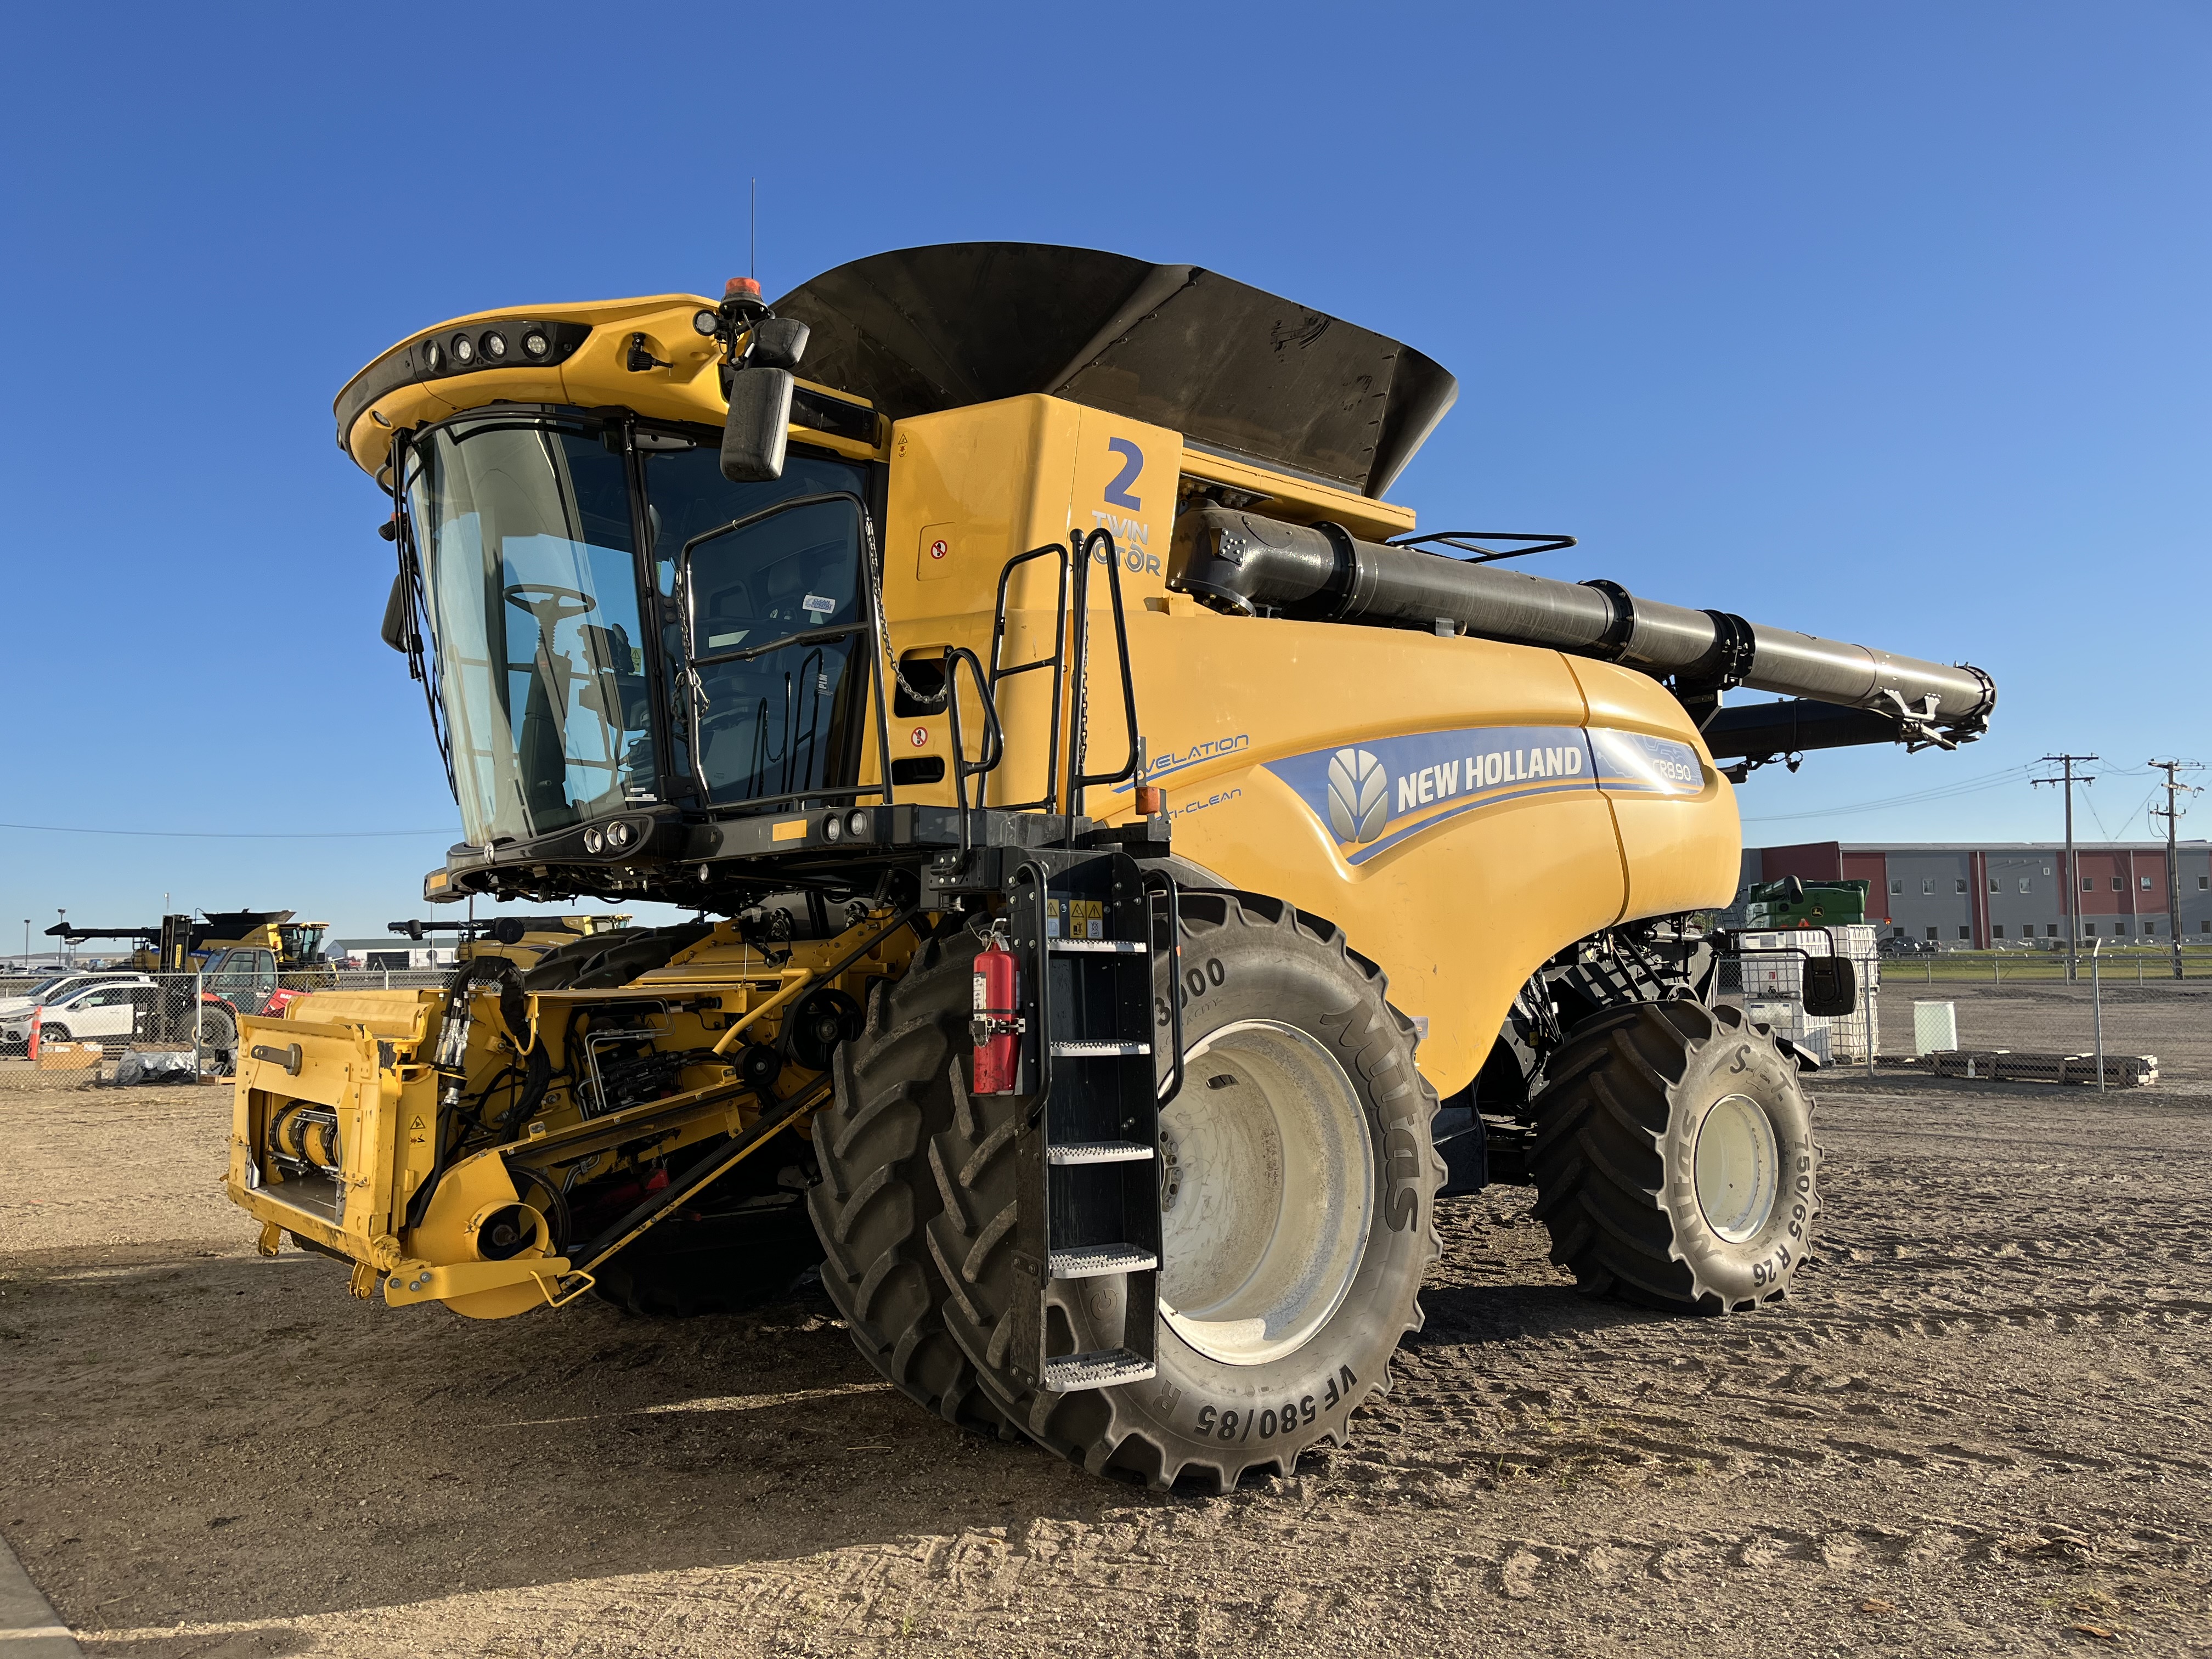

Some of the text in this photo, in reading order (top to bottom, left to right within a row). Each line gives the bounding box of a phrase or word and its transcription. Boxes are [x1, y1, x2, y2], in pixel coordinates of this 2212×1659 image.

[1104, 437, 1144, 512] 2
[1092, 510, 1148, 545] TWIN
[1092, 537, 1161, 577] OTOR
[818, 674, 828, 690] PLM
[1109, 734, 1249, 786] VELATION
[1398, 747, 1582, 813] NEW HOLLAND
[1652, 759, 1692, 781] CR8.90
[1155, 788, 1242, 821] I-CLEAN
[1319, 1000, 1420, 1233] Mitas
[1673, 1108, 1723, 1262] Mitas
[1787, 1133, 1810, 1243] 750/65
[1752, 1259, 1776, 1288] 26
[1775, 1243, 1791, 1270] R
[1153, 1364, 1358, 1444] VF 580/85 R
